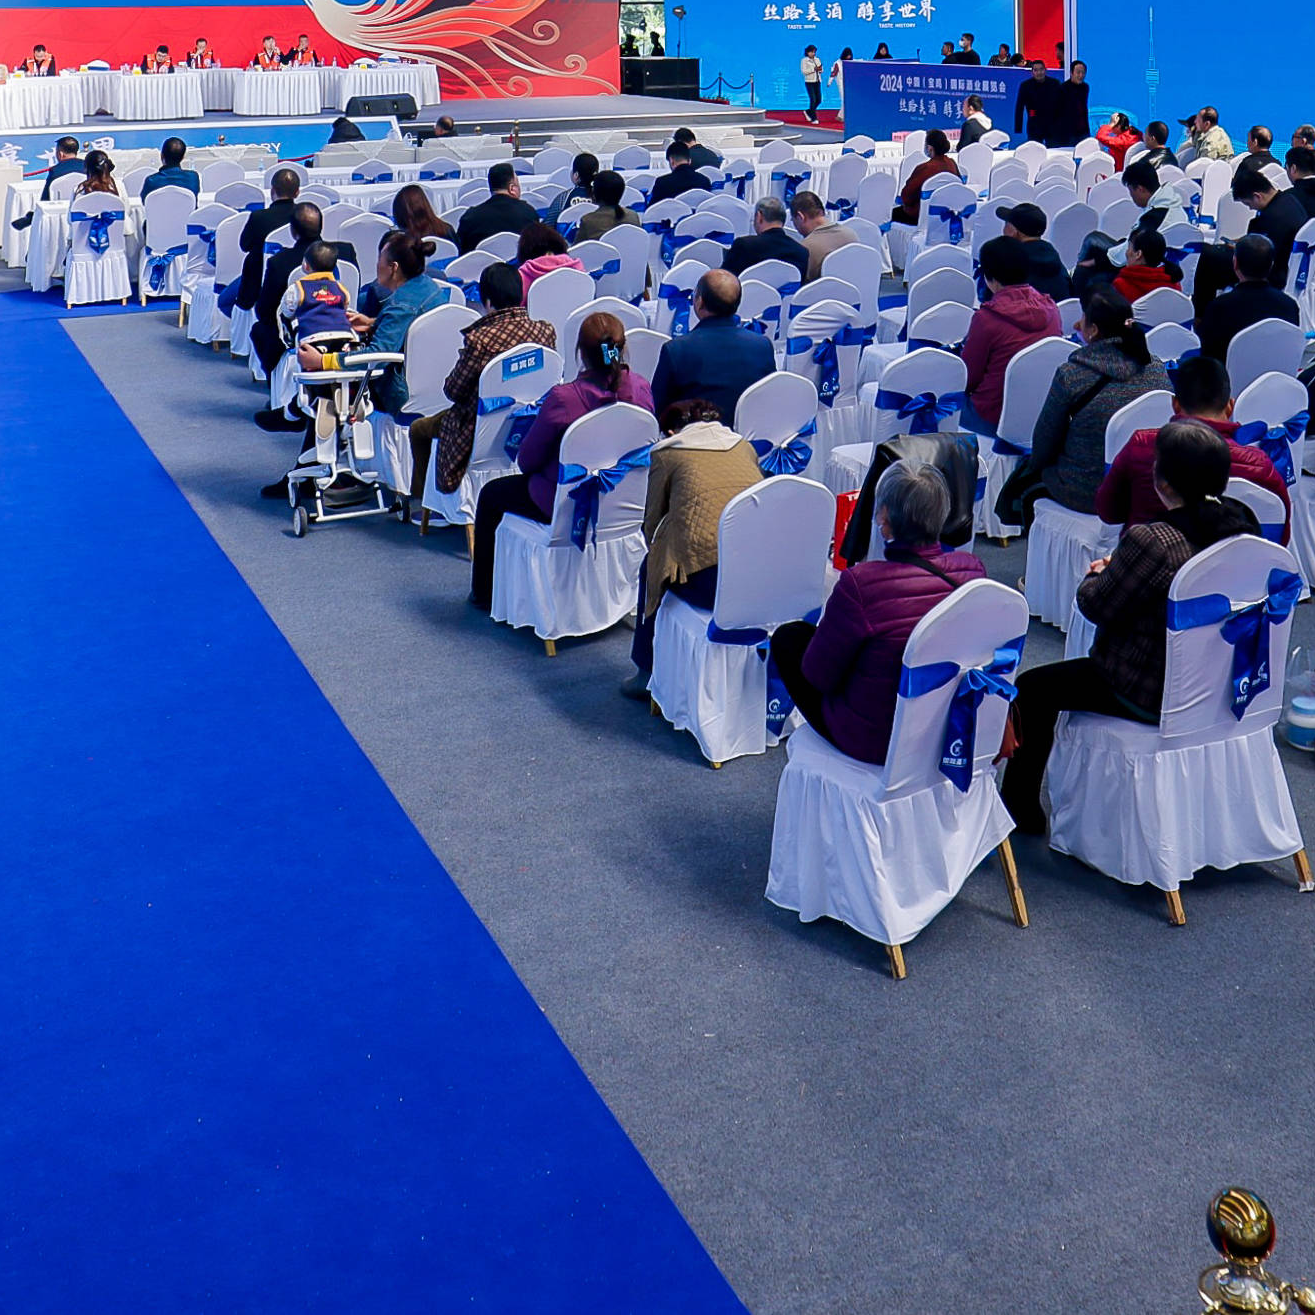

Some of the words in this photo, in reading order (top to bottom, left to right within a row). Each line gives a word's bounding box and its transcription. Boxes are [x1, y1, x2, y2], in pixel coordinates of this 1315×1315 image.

[763, 2, 843, 22] 丝路美酒
[880, 73, 903, 93] 2024
[943, 99, 964, 119] 醇享
